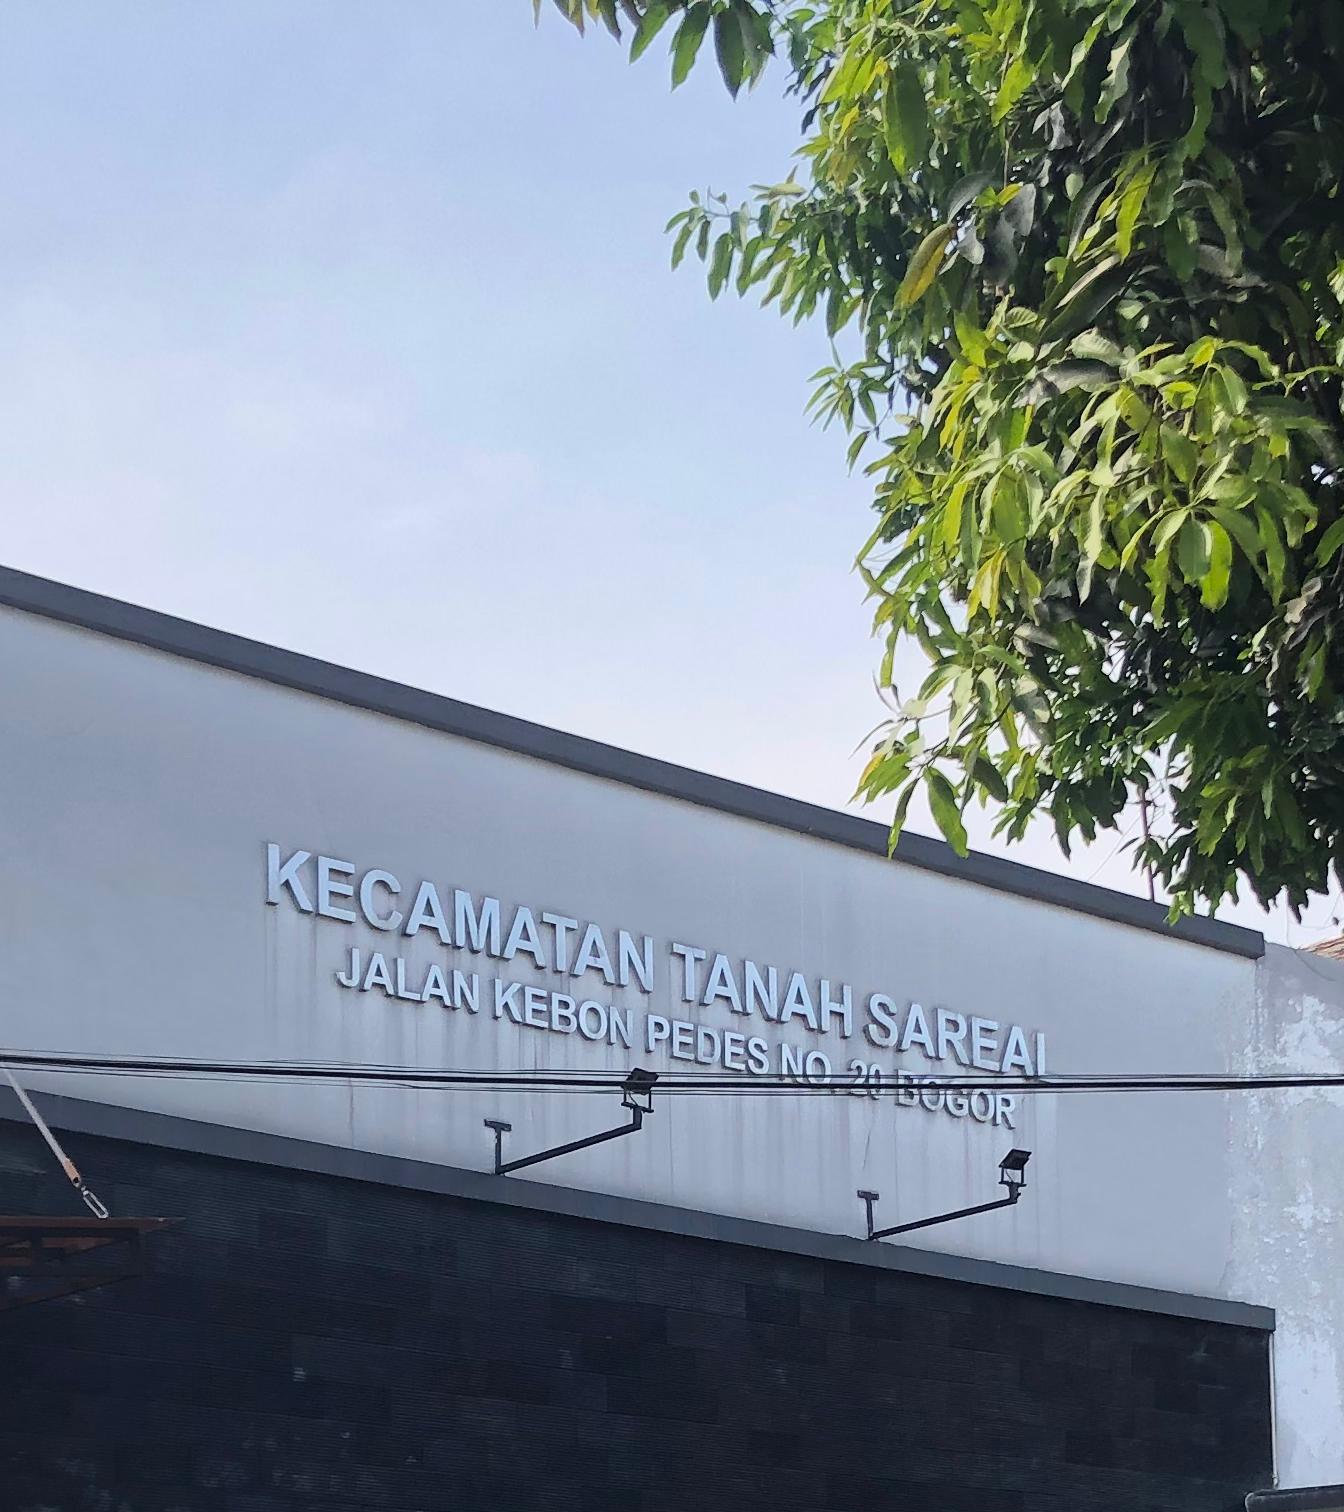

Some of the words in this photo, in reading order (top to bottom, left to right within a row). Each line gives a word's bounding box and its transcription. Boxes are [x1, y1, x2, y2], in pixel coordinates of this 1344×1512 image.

[266, 842, 654, 993] KECAMATAN
[671, 942, 853, 1039] TANAH
[336, 947, 480, 1014] JALAN
[493, 978, 634, 1049] KEBON
[644, 1014, 770, 1076] PEDES
[849, 1057, 884, 1100] 20
[895, 1068, 1017, 1130] BOGOR
